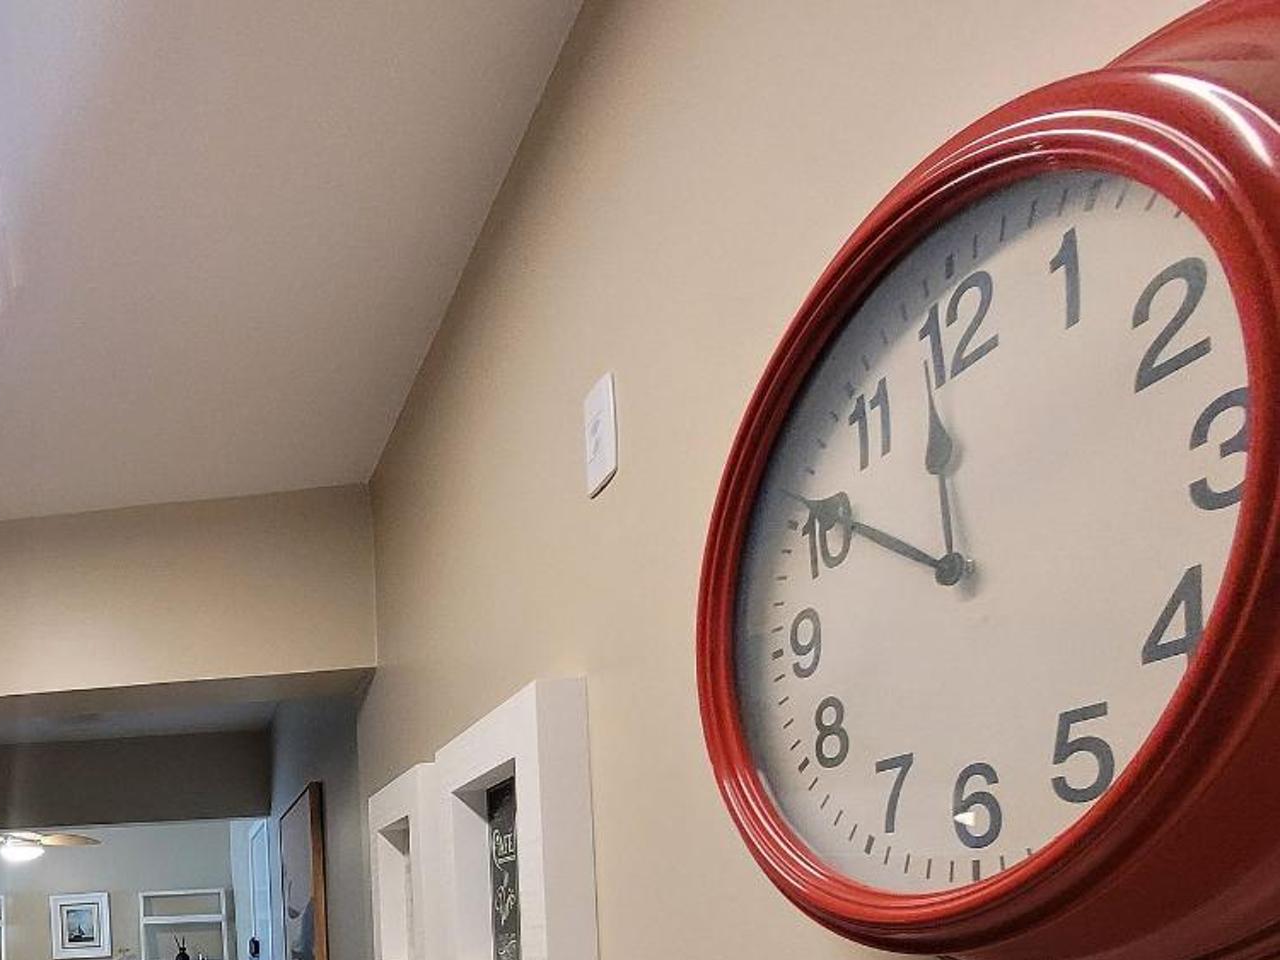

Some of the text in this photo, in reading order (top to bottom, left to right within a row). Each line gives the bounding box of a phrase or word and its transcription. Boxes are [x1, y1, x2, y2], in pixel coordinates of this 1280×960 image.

[1049, 227, 1081, 330] 1
[1132, 256, 1212, 394] 2
[918, 270, 999, 391] 12
[848, 377, 891, 472] 11
[1189, 386, 1249, 511] 3
[801, 491, 852, 581] 10
[789, 608, 821, 679] 9
[1141, 563, 1204, 666] 4
[814, 696, 850, 769] 8
[1050, 701, 1116, 803] 5
[875, 753, 914, 834] 7
[953, 762, 1003, 850] 6
